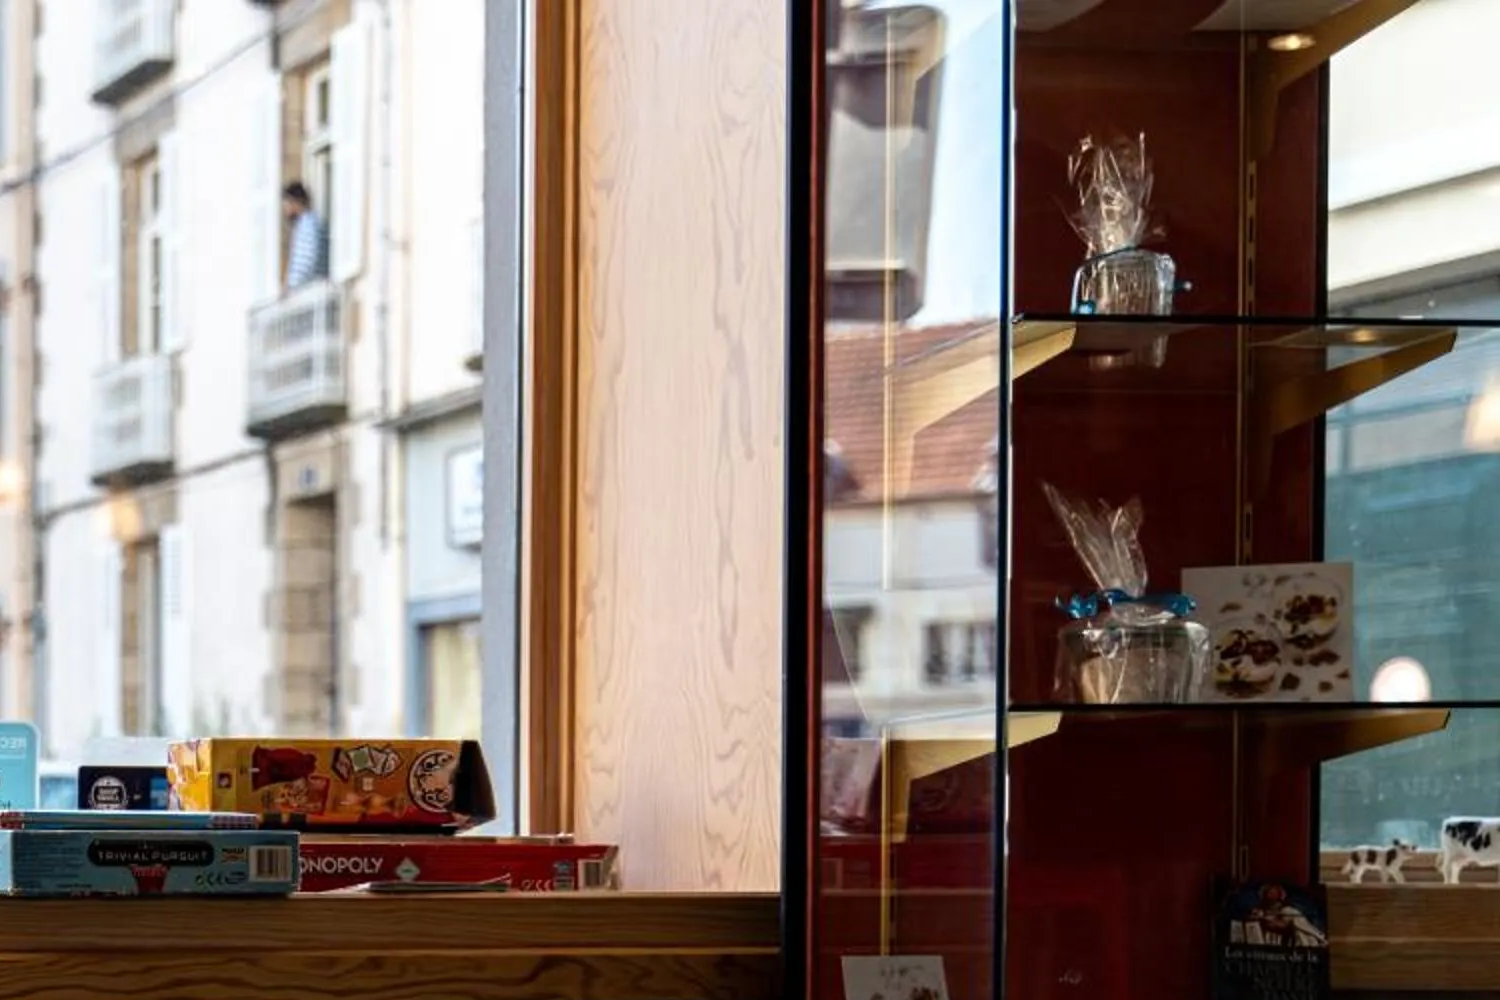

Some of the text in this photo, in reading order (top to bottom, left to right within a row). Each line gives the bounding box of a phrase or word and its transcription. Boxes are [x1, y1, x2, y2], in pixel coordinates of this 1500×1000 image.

[97, 850, 148, 862] TRIVIAL
[151, 849, 208, 862] PURSUIT
[300, 857, 384, 873] ONOPOLY
